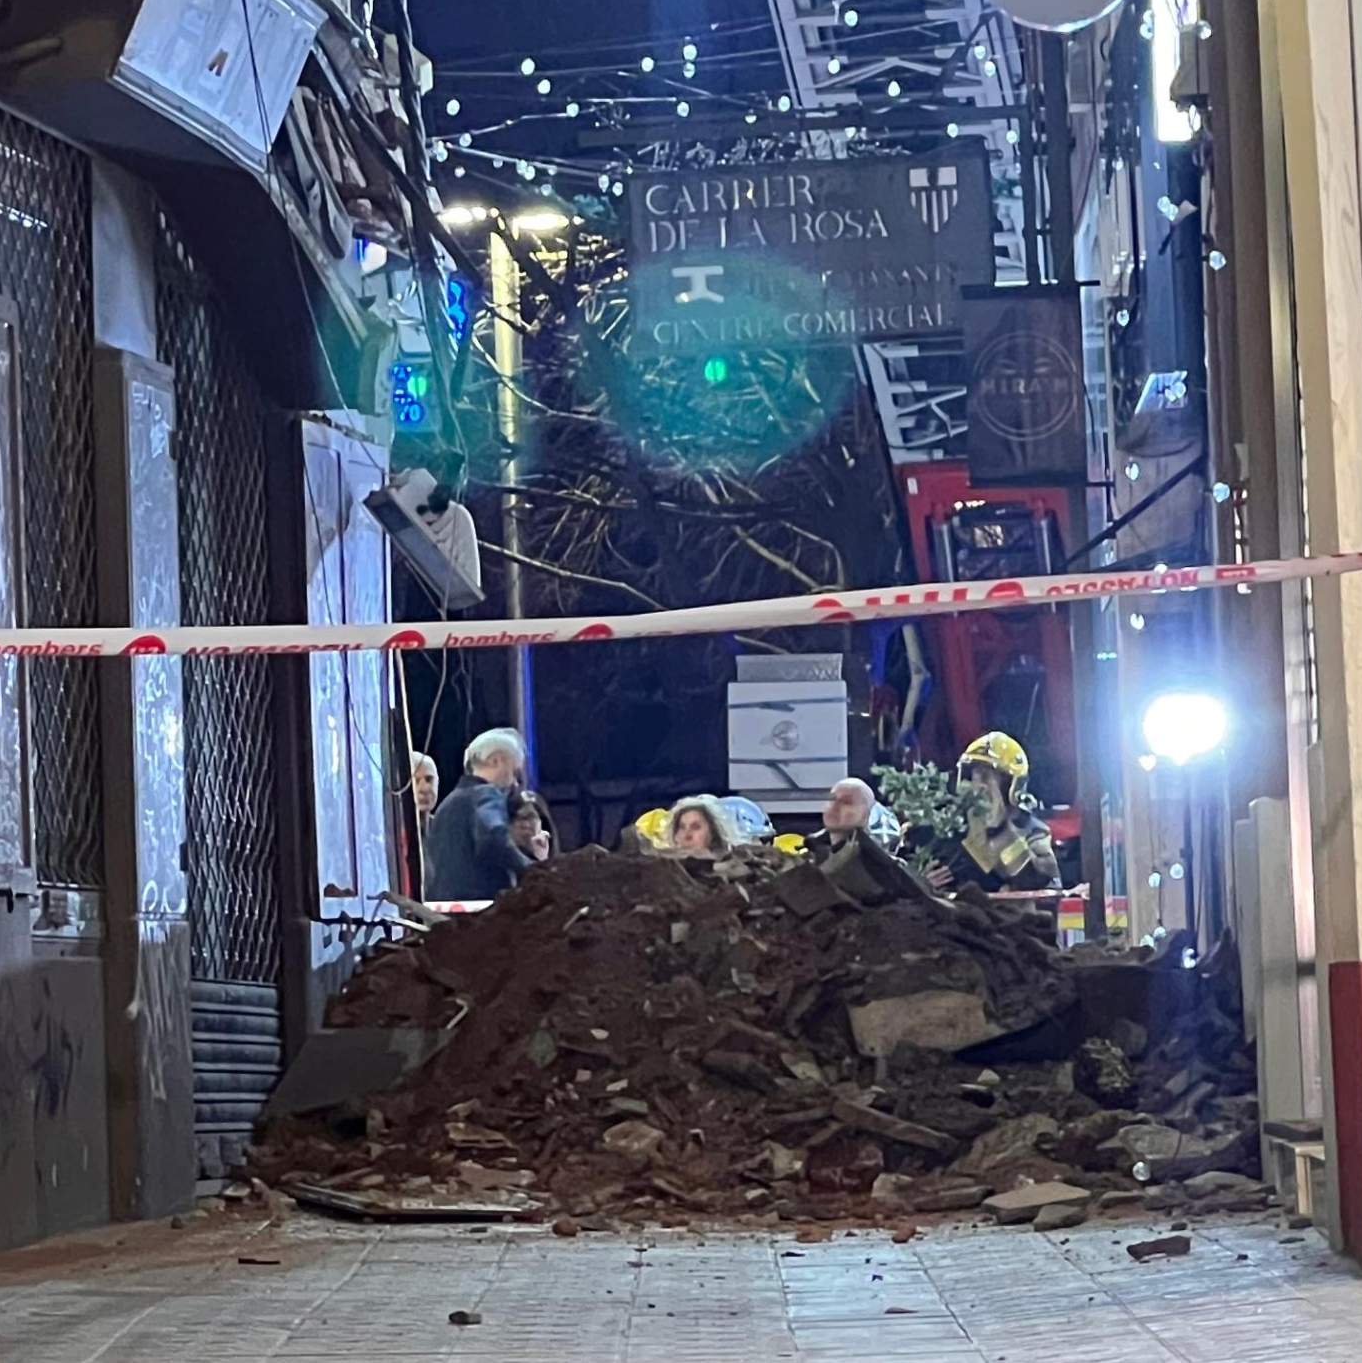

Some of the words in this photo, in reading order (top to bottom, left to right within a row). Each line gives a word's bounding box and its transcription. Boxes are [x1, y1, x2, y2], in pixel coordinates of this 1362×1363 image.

[644, 175, 815, 217] CARRER
[790, 208, 889, 244] ROSA
[783, 302, 952, 337] COMERCIAL
